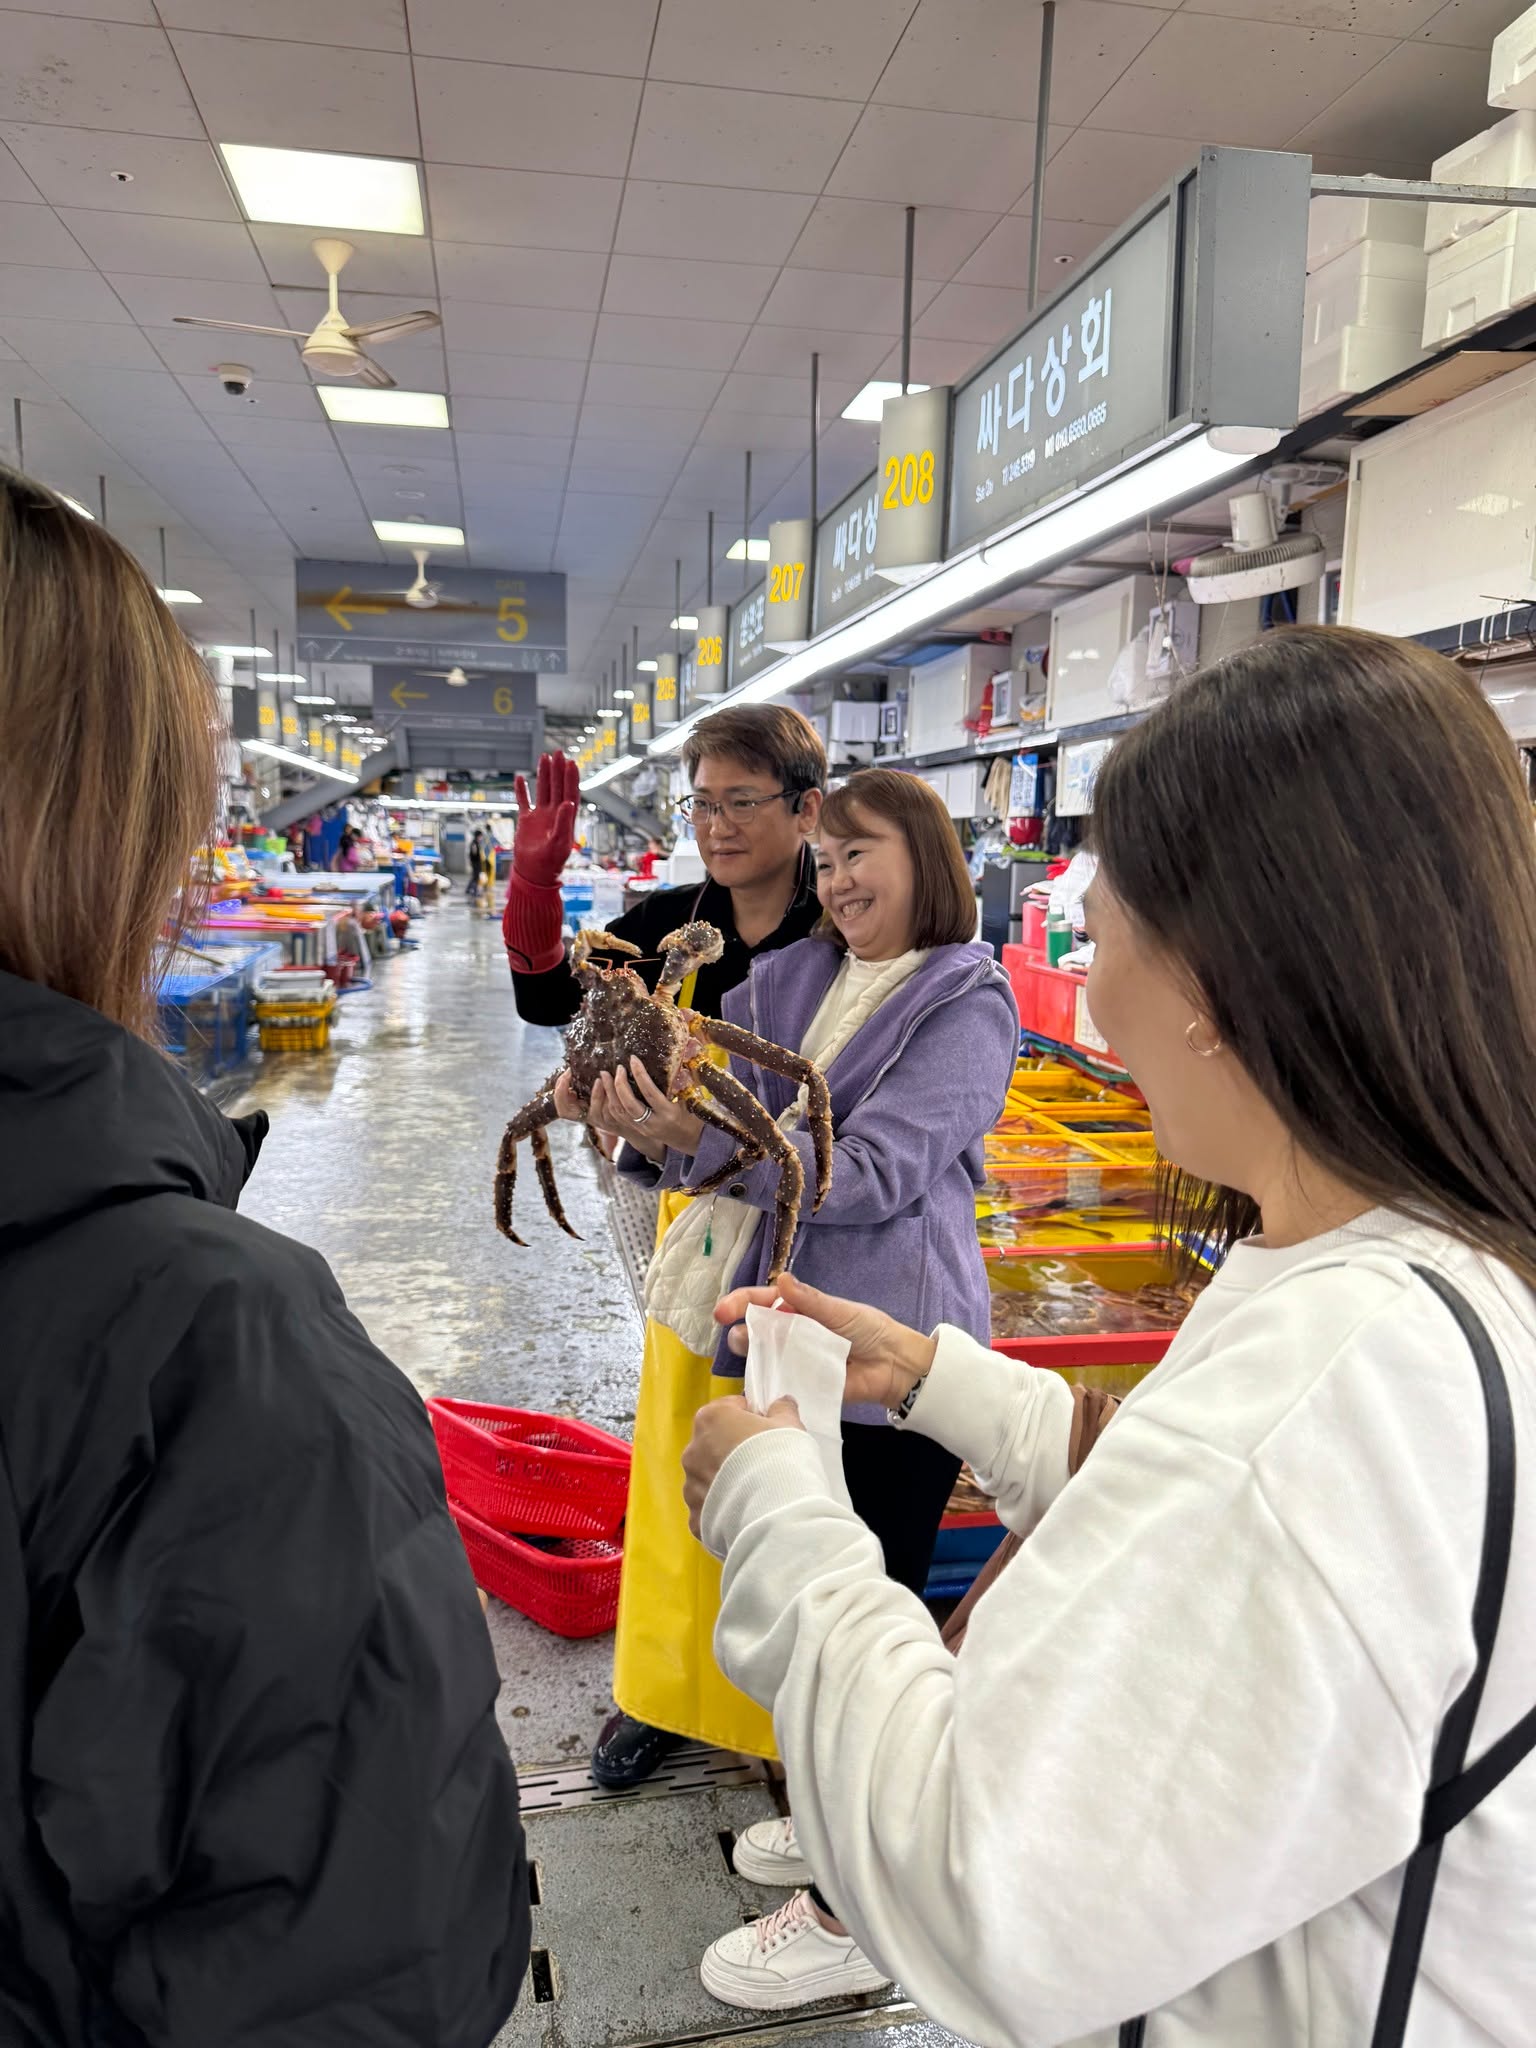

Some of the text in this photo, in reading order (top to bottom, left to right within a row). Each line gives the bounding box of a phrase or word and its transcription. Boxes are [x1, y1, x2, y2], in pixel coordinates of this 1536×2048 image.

[977, 288, 1111, 455] 싸다상회
[883, 449, 935, 510] 208
[769, 562, 805, 603] 207
[496, 597, 528, 642] 5
[697, 636, 722, 666] 206
[493, 687, 514, 715] 6
